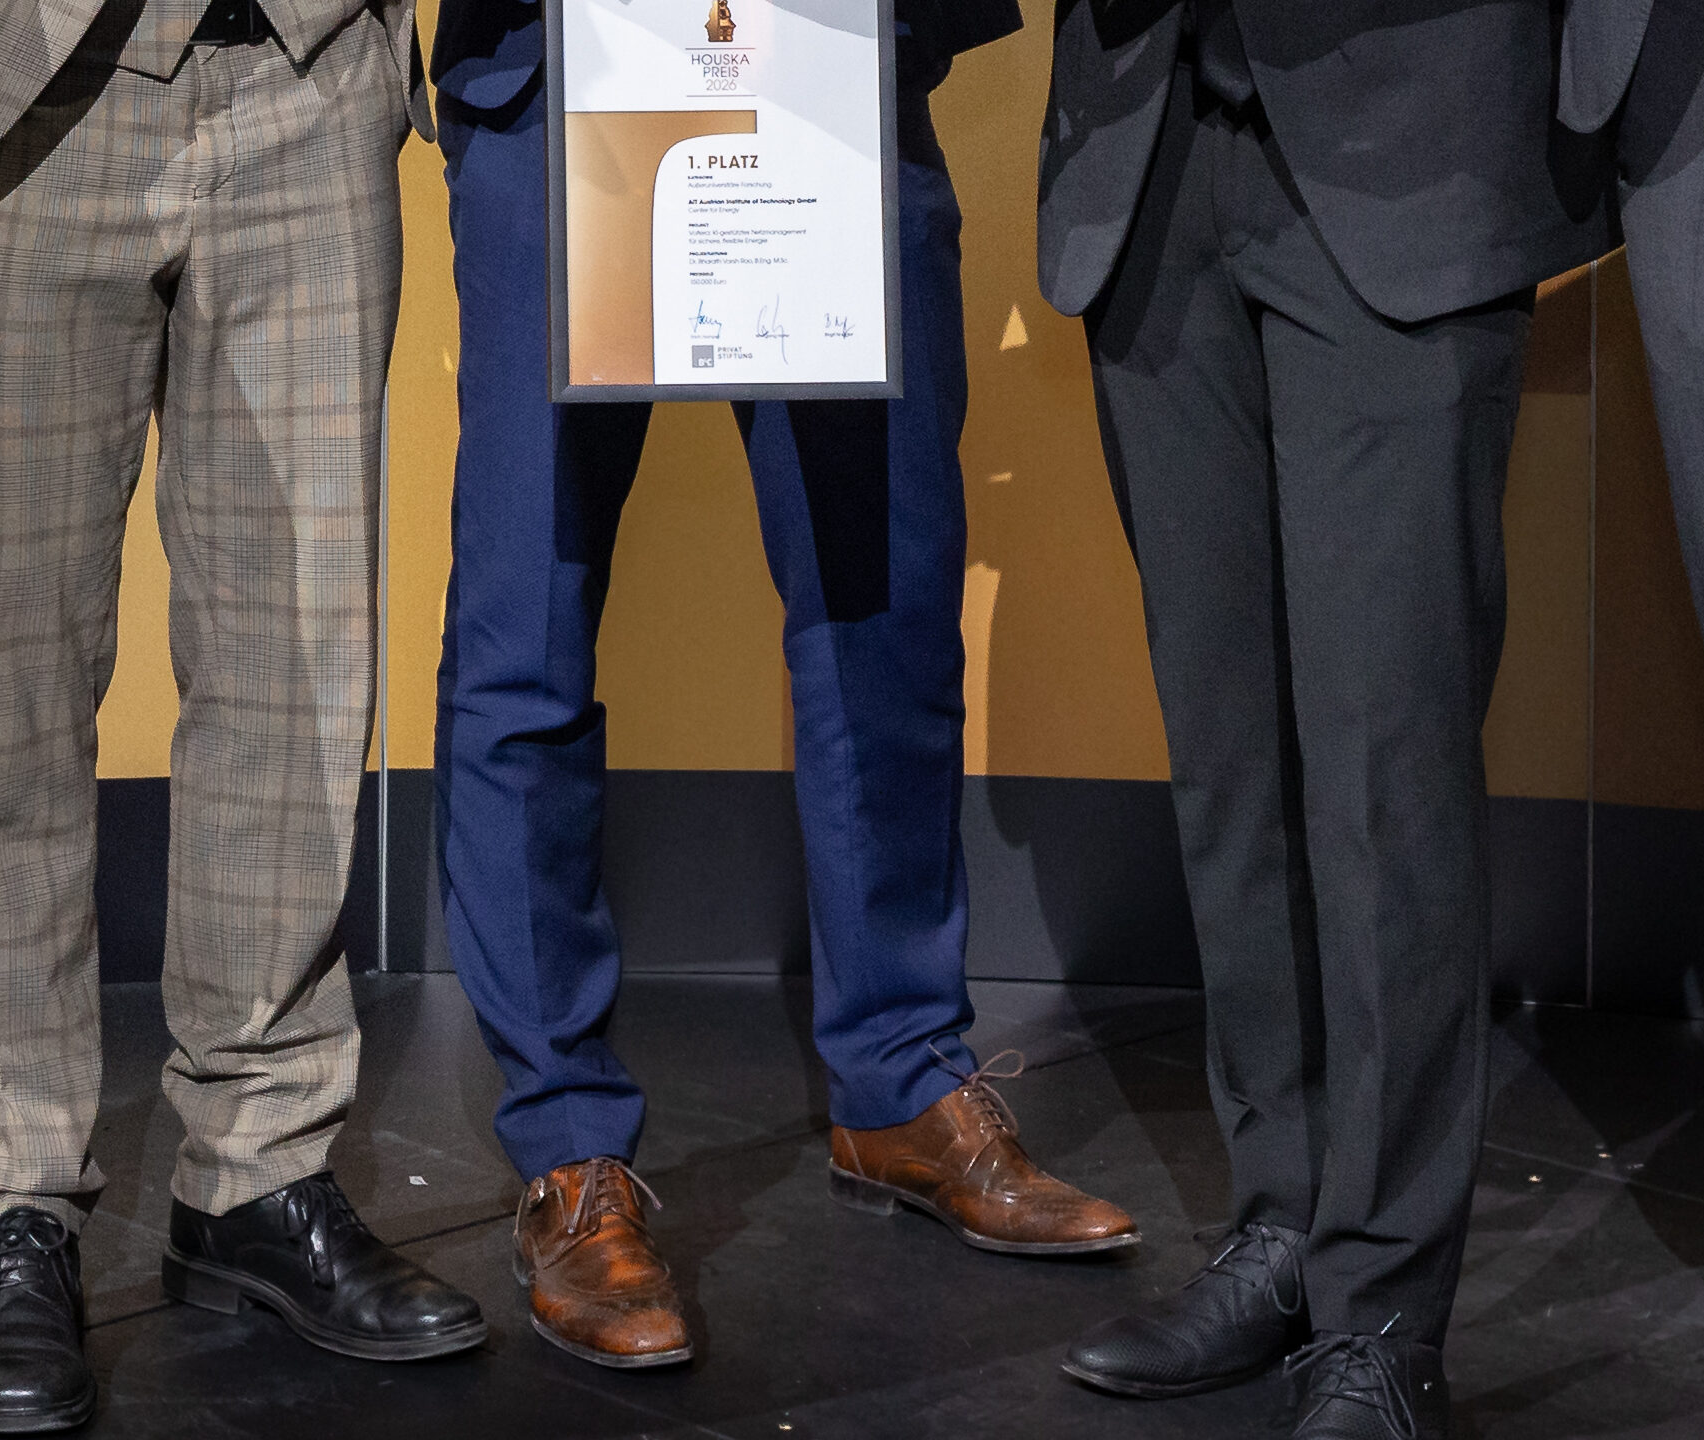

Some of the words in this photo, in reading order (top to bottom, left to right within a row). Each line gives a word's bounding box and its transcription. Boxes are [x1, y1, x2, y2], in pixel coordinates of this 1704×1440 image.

[691, 53, 750, 65] HOUSKA
[703, 66, 739, 78] PREIS
[705, 78, 737, 91] 2026
[688, 155, 701, 169] 1.
[708, 154, 759, 169] PLATZ
